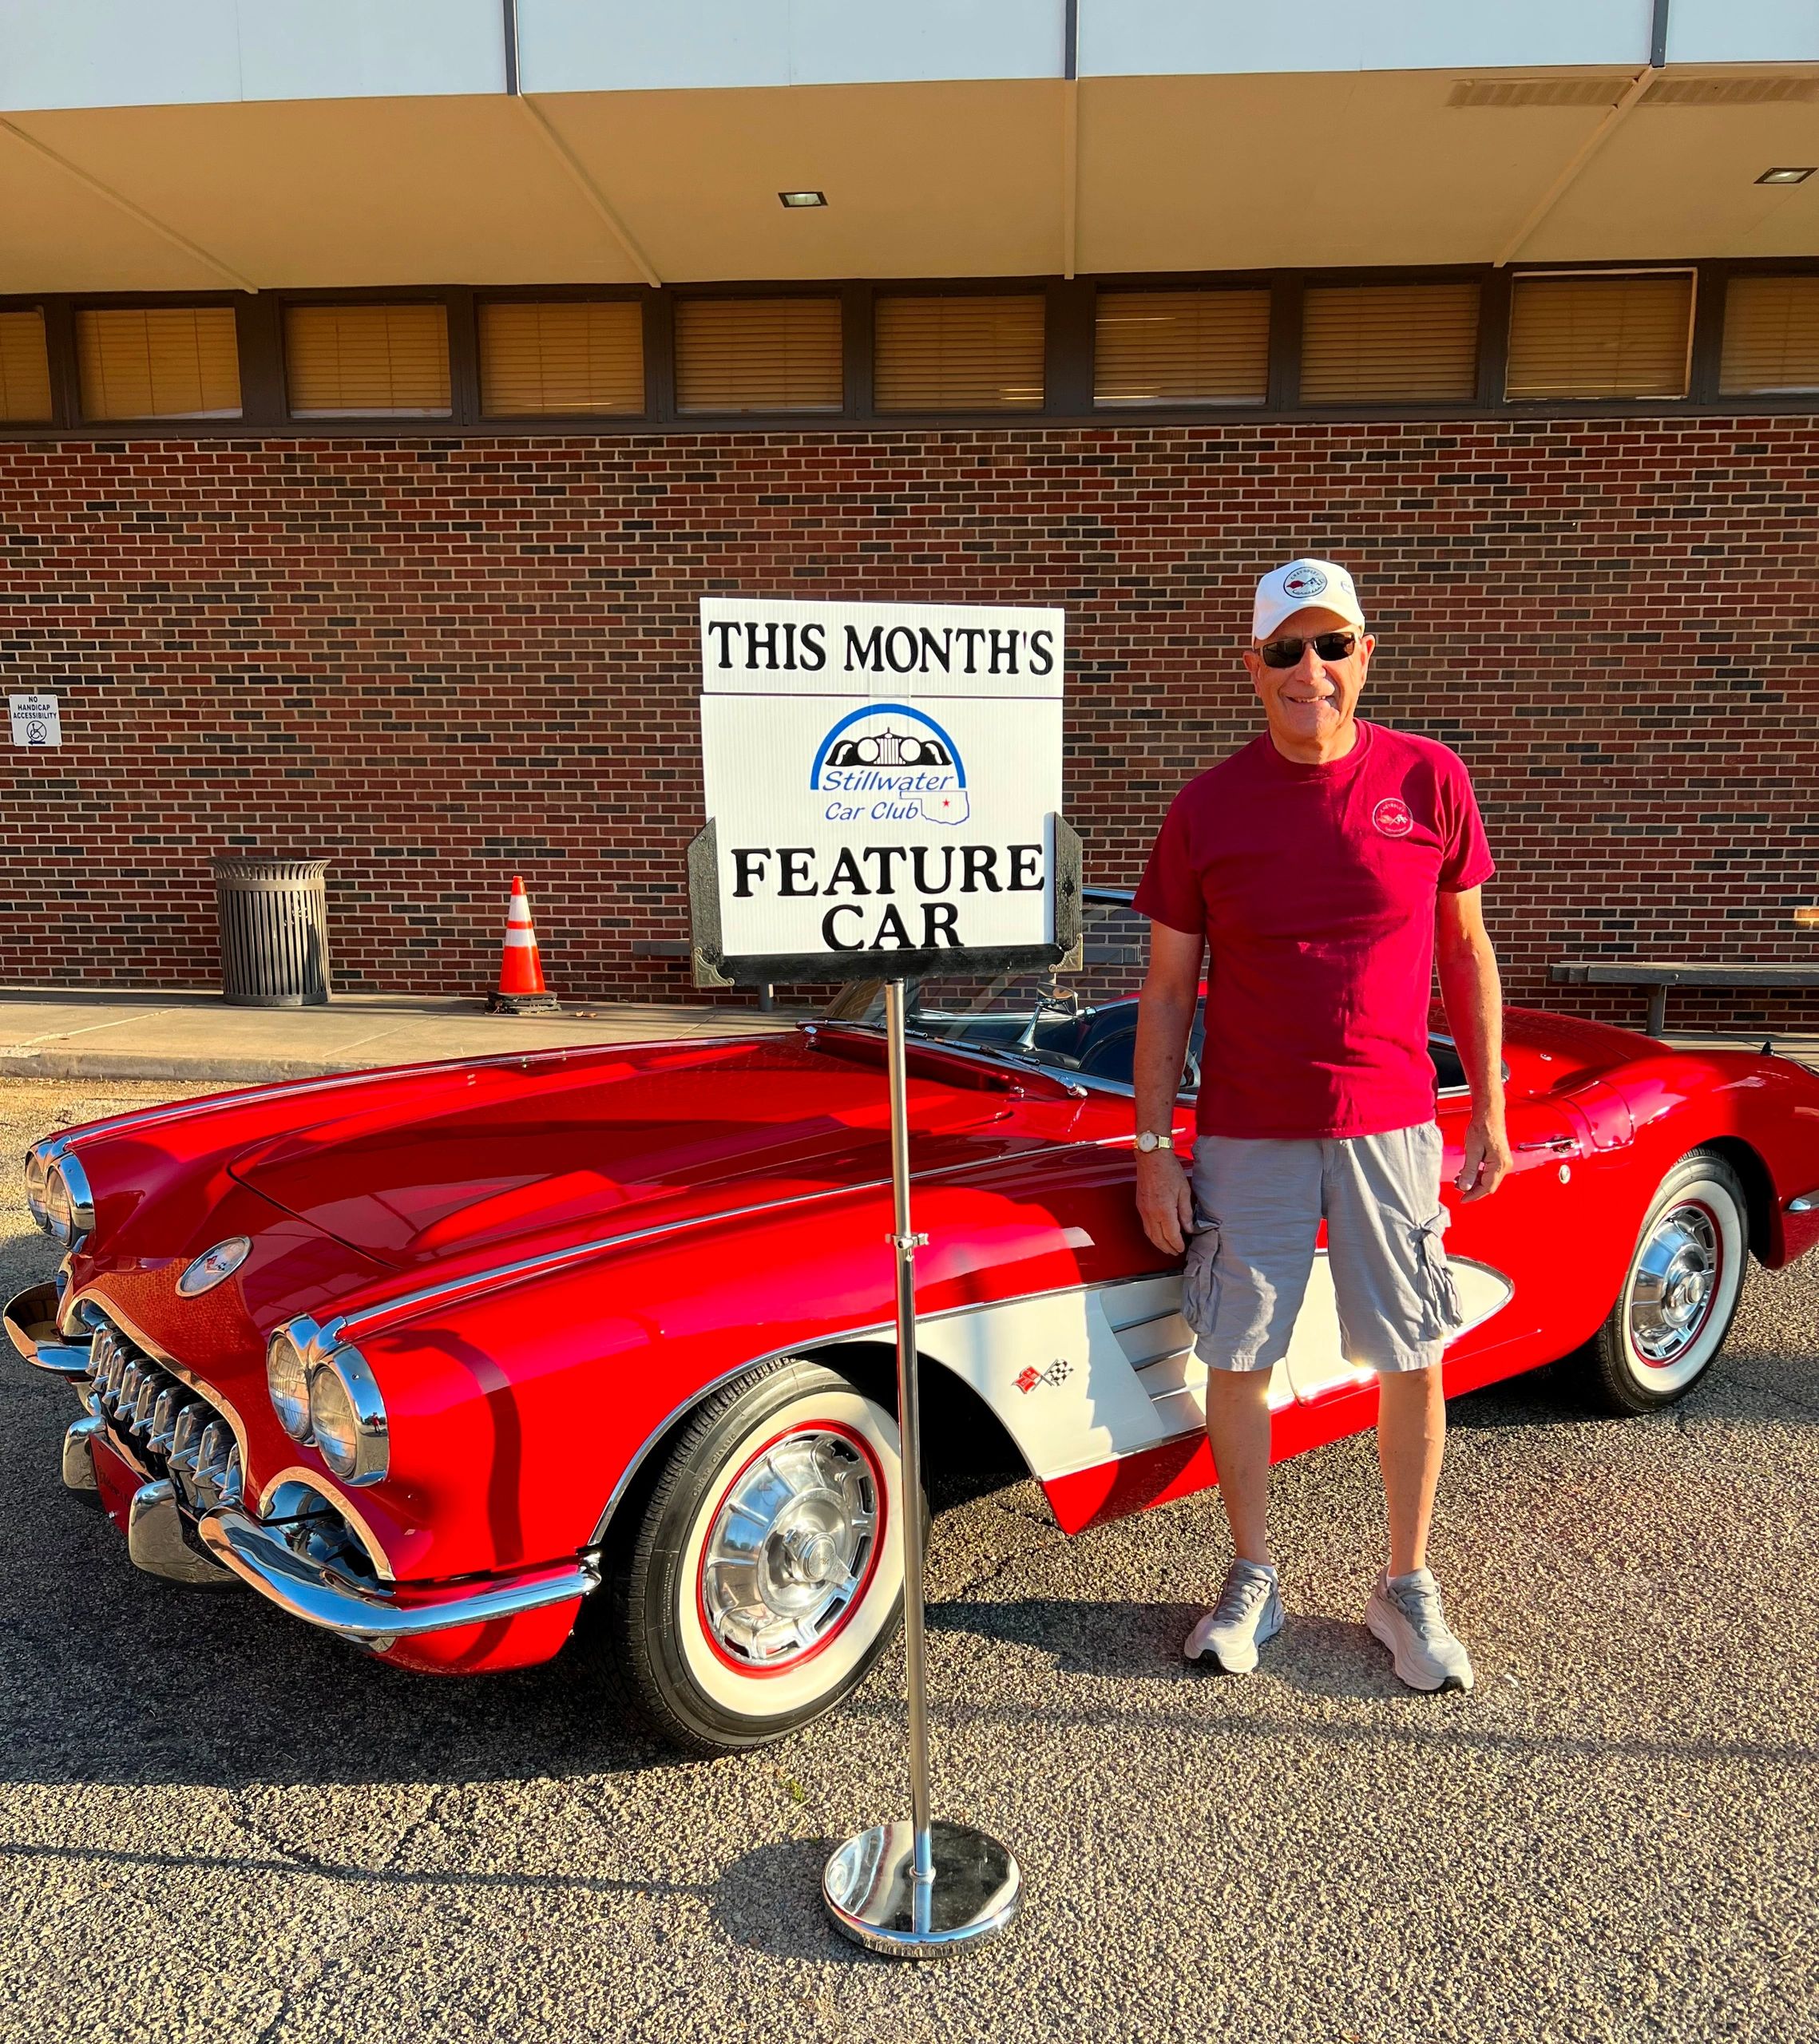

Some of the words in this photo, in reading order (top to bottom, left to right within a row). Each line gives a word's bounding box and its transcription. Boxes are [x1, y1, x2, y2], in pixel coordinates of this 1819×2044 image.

[707, 620, 826, 671] THIS
[843, 624, 1054, 676] MONTH'S
[822, 770, 954, 791] Stillwater
[825, 802, 866, 821] Car
[870, 801, 919, 820] Club
[731, 844, 1045, 898] FEATURE
[822, 902, 965, 951] CAR
